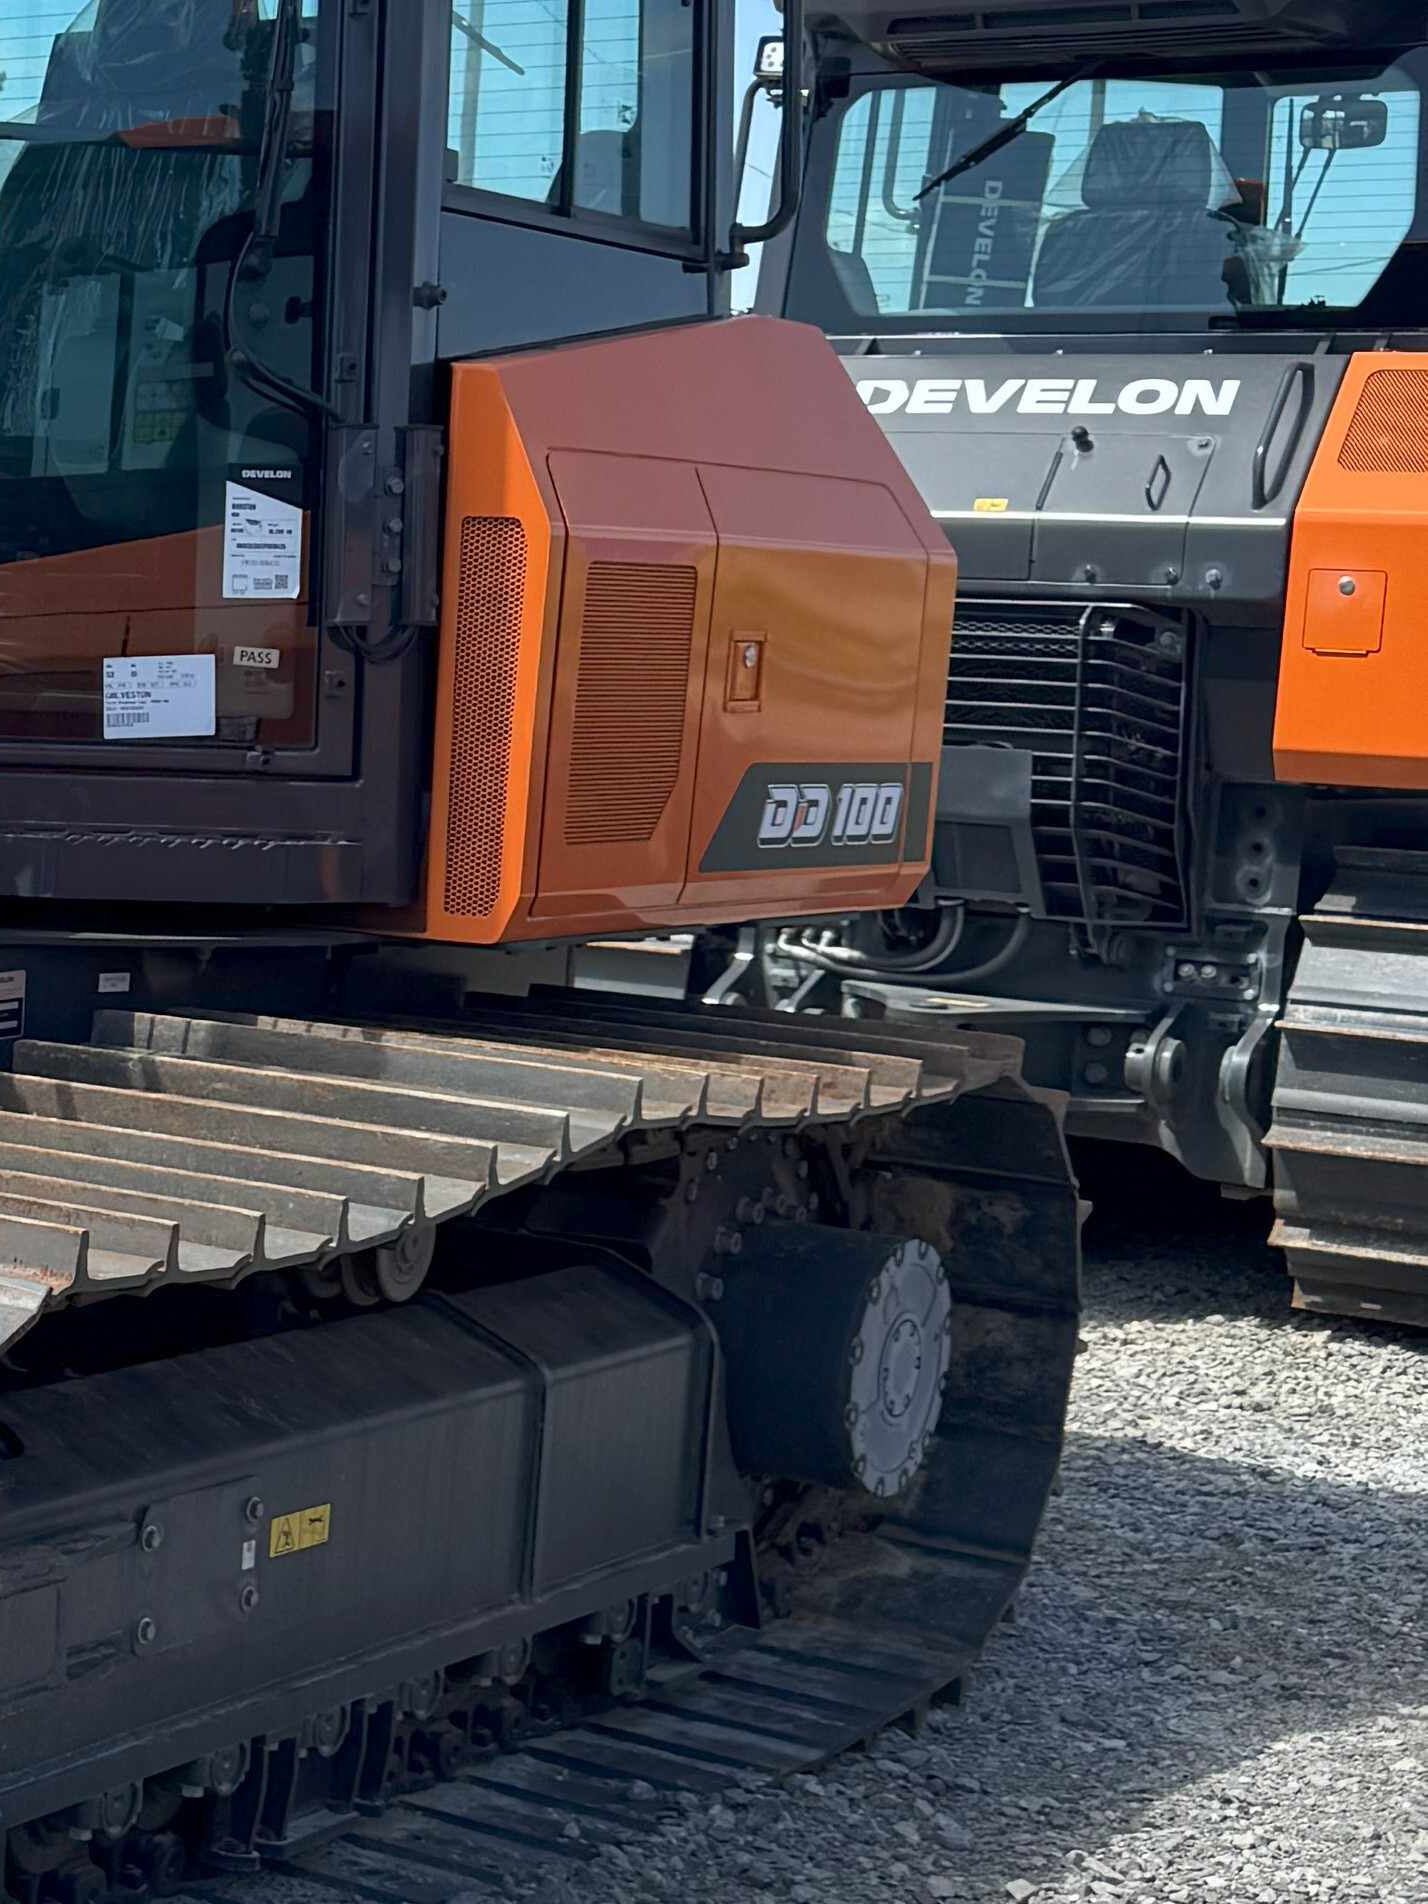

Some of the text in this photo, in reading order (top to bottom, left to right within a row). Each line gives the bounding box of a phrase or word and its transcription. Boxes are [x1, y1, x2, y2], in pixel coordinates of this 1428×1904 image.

[856, 379, 1241, 415] DEVELON
[241, 469, 292, 479] DEVELON
[239, 650, 273, 664] PASS
